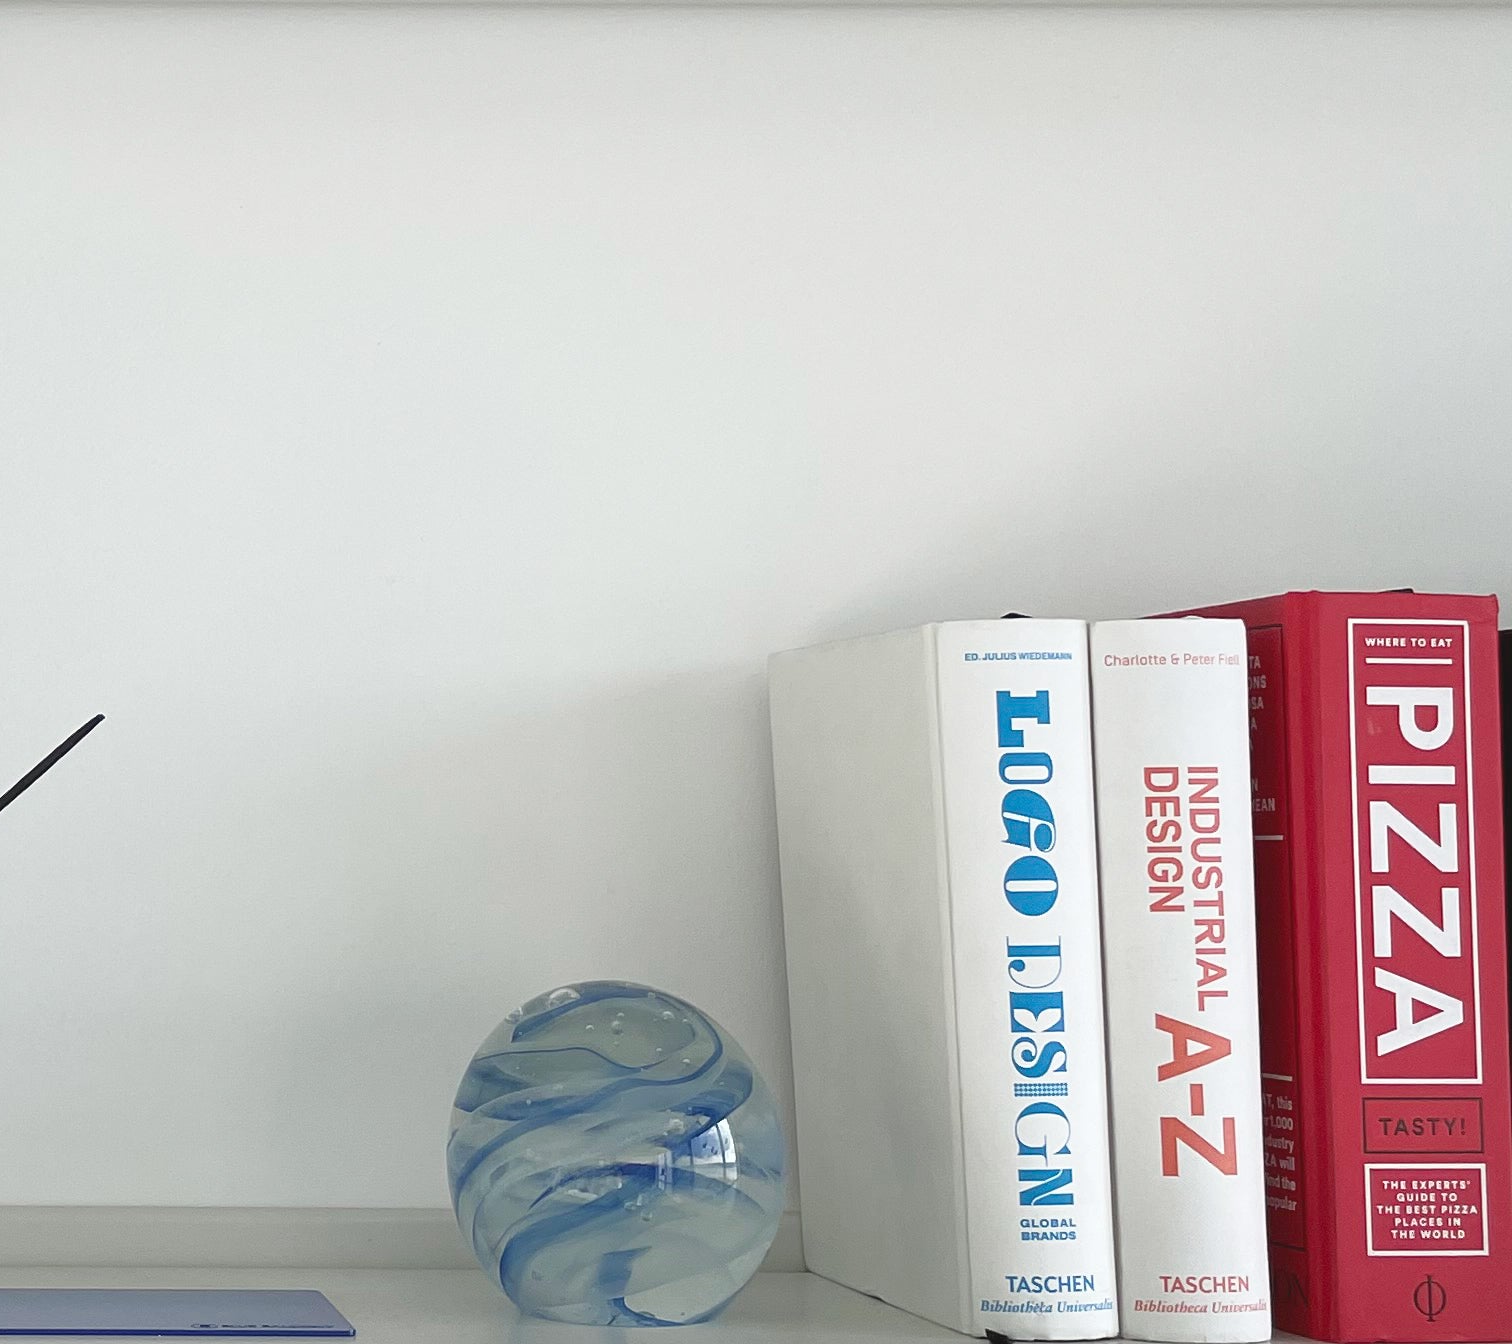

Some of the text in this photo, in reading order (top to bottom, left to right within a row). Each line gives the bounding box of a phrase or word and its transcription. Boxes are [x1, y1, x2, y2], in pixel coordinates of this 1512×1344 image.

[1365, 637, 1453, 648] WHERE TO EAT
[964, 652, 1072, 661] ED. JULIUS WIEDEMANN
[1104, 654, 1240, 668] Charlotte & Peter Fiell
[1144, 766, 1185, 913] DESIGN
[1366, 687, 1464, 1057] PIZZA
[1187, 766, 1228, 1012] INDUSTRIAL
[995, 689, 1075, 1206] LOGO DESIGN
[1154, 1012, 1238, 1177] A-Z
[1378, 1117, 1467, 1136] TASTY!
[1396, 1193, 1458, 1202] GUIDE TO
[1377, 1205, 1478, 1215] THE BEST PIZZA
[1020, 1219, 1077, 1241] GLOBAL BRANDS
[1394, 1217, 1461, 1227] PLACES IN
[1391, 1229, 1466, 1239] THE WORLD
[1005, 1274, 1095, 1293] TASCHEN
[1159, 1275, 1250, 1293] TASCHEN
